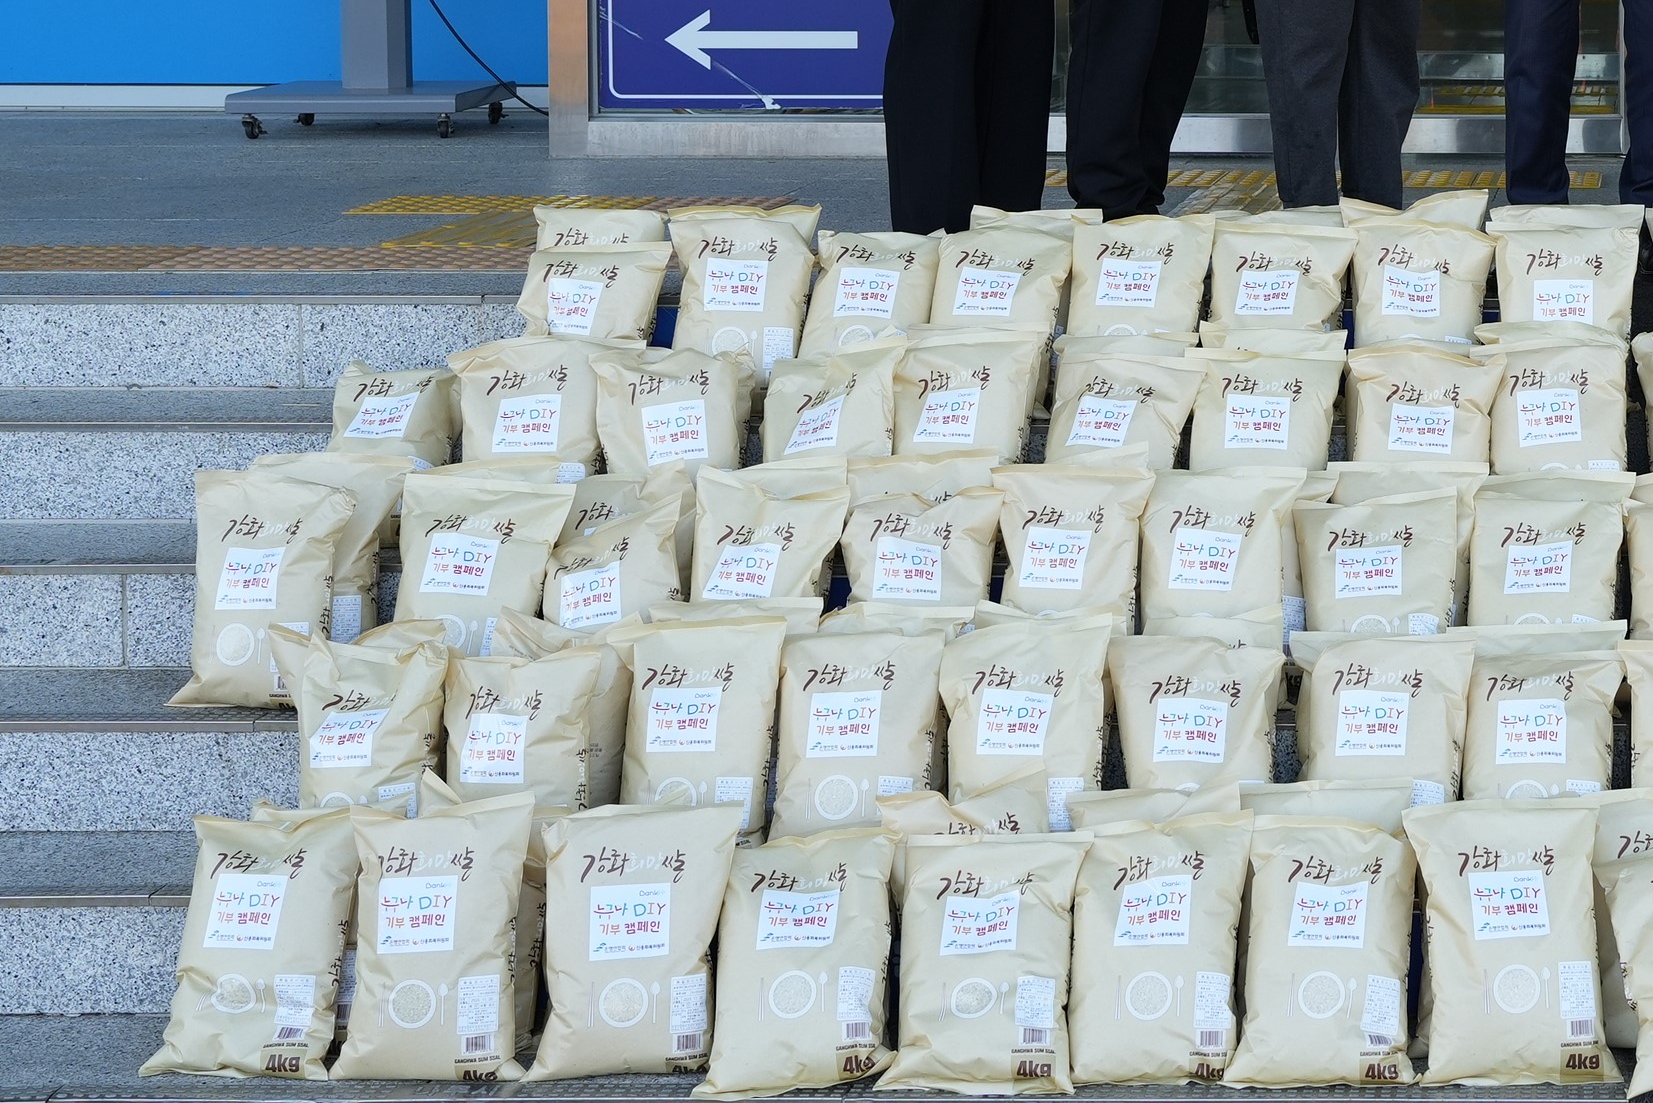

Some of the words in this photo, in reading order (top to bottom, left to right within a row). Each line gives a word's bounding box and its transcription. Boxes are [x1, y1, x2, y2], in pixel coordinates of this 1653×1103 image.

[216, 891, 245, 907] 누구나
[249, 894, 280, 908] DIY
[1474, 888, 1506, 902] 누구나
[1510, 887, 1541, 900] DIY
[1481, 904, 1501, 916] 기부
[1504, 903, 1539, 916] 캠페인
[217, 911, 234, 923] 기부
[237, 911, 271, 925] 캠페인
[265, 1054, 301, 1073] 4kg
[1565, 1053, 1600, 1070] 4kg
